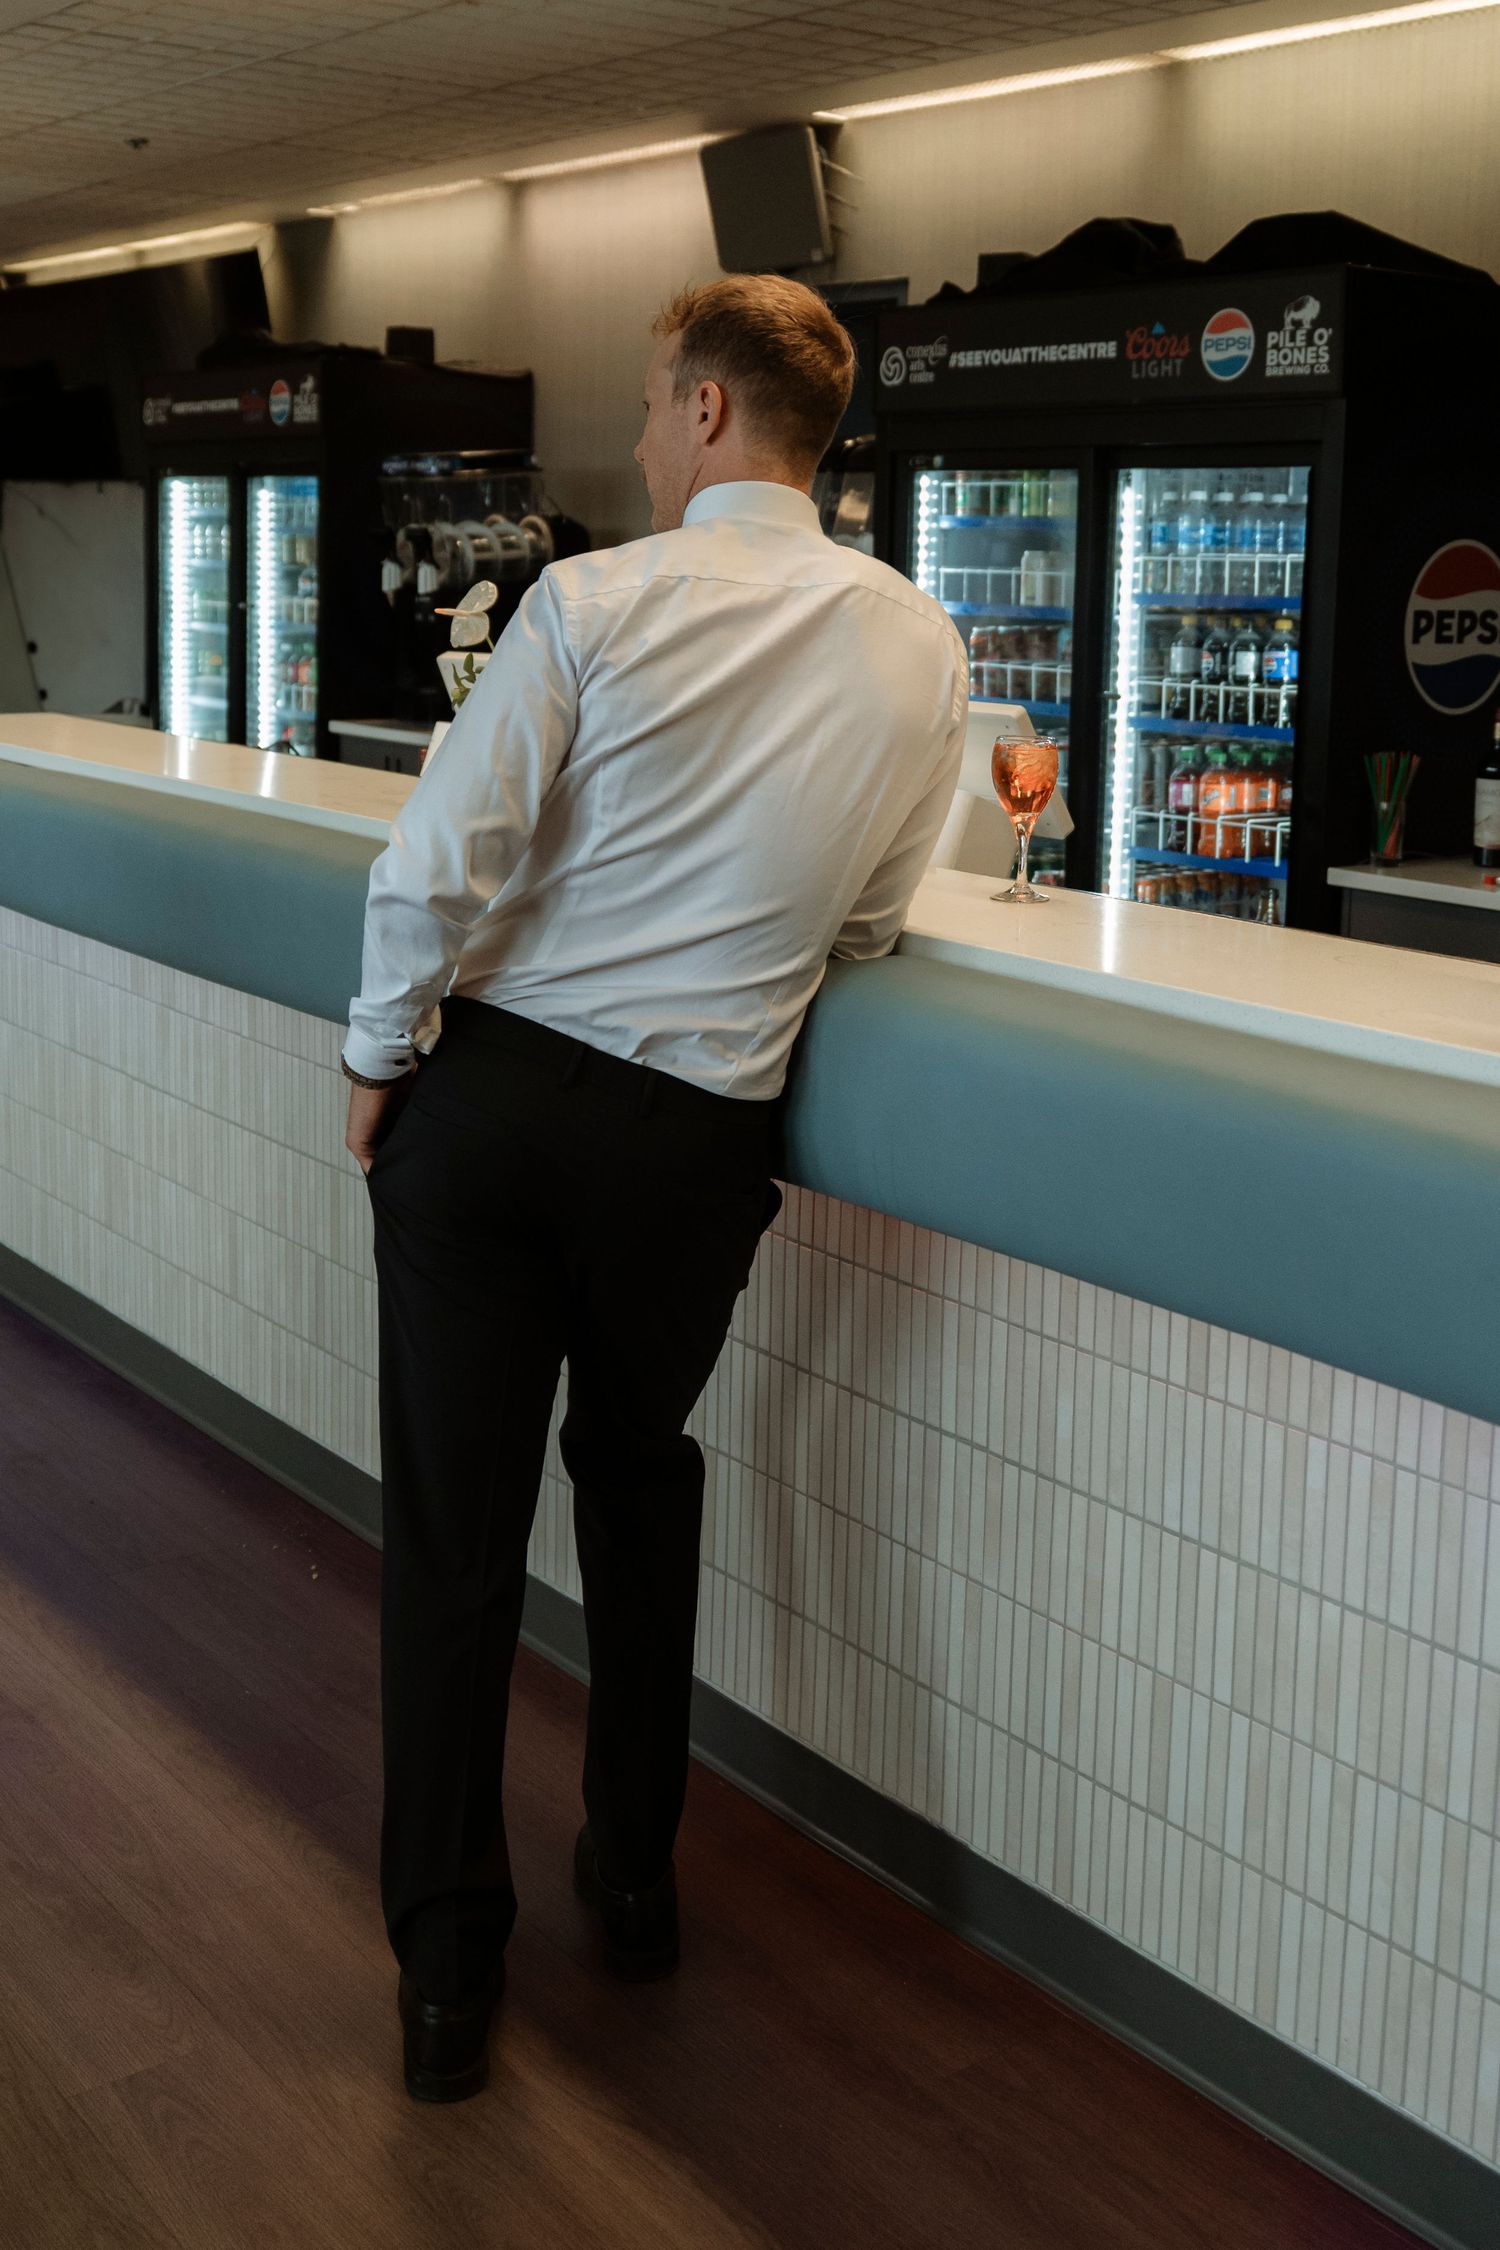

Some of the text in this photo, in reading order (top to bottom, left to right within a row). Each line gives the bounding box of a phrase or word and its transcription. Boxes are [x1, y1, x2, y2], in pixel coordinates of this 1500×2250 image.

[1125, 327, 1191, 360] Coors
[1203, 335, 1252, 352] PEPSI
[1266, 327, 1333, 350] PILE O'
[948, 340, 1118, 368] #SEEYOUATTHECENTRE
[1265, 345, 1330, 366] BONES
[1131, 358, 1184, 379] LIGHT
[1264, 364, 1311, 377] BREWING
[1411, 610, 1500, 644] PEPS
